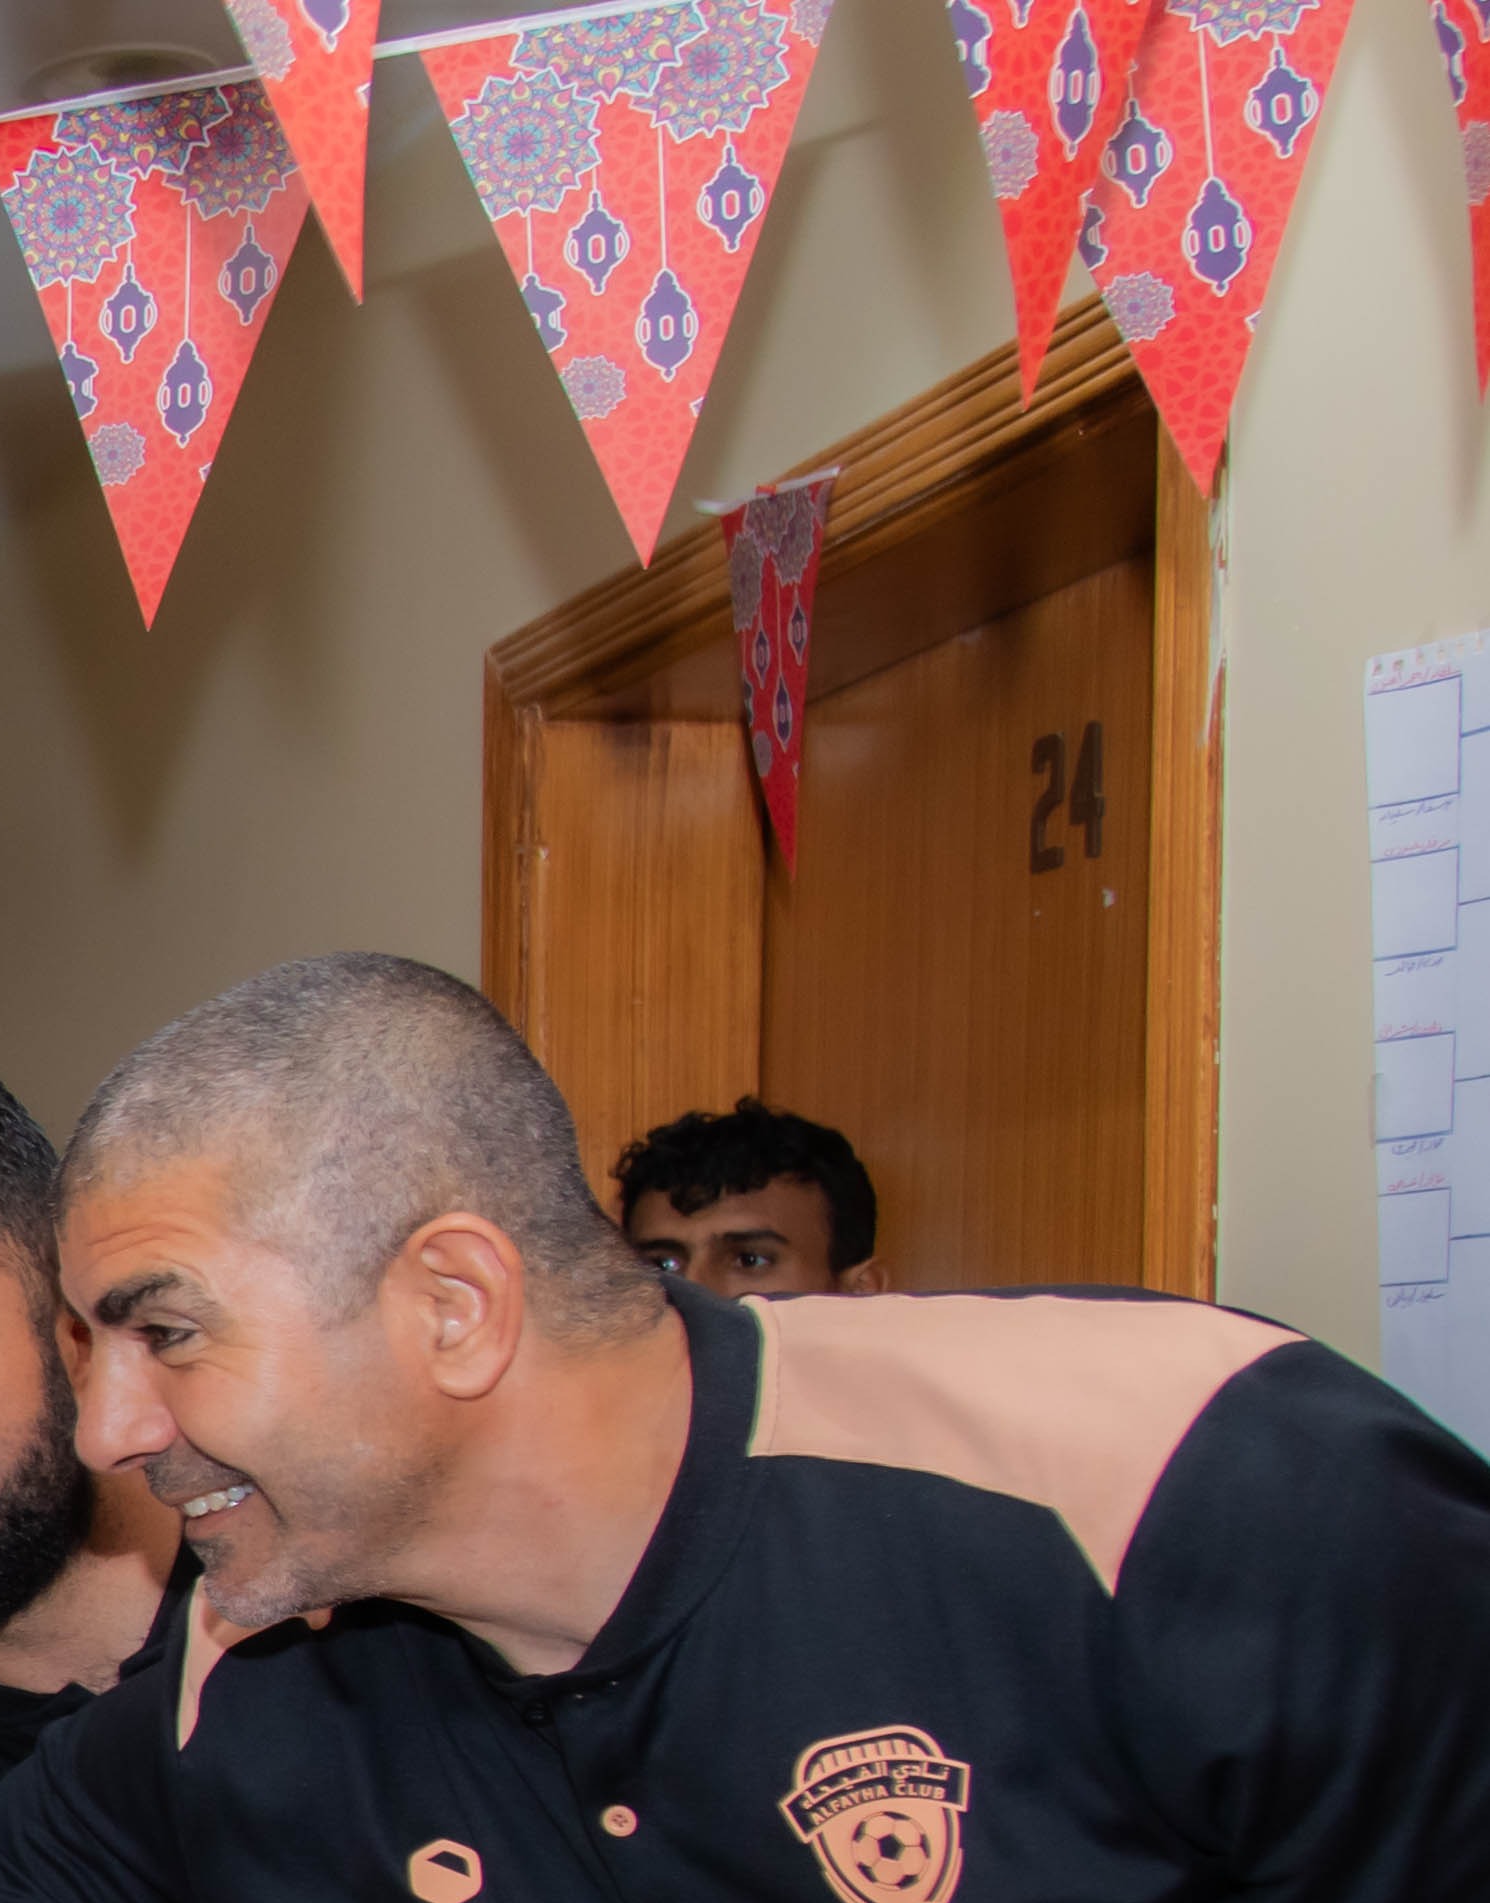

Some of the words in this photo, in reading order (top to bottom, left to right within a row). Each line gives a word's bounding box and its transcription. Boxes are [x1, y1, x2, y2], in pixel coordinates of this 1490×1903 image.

[1030, 720, 1107, 875] 24
[809, 1784, 889, 1827] ALFAYHA
[893, 1783, 947, 1800] CLUB
